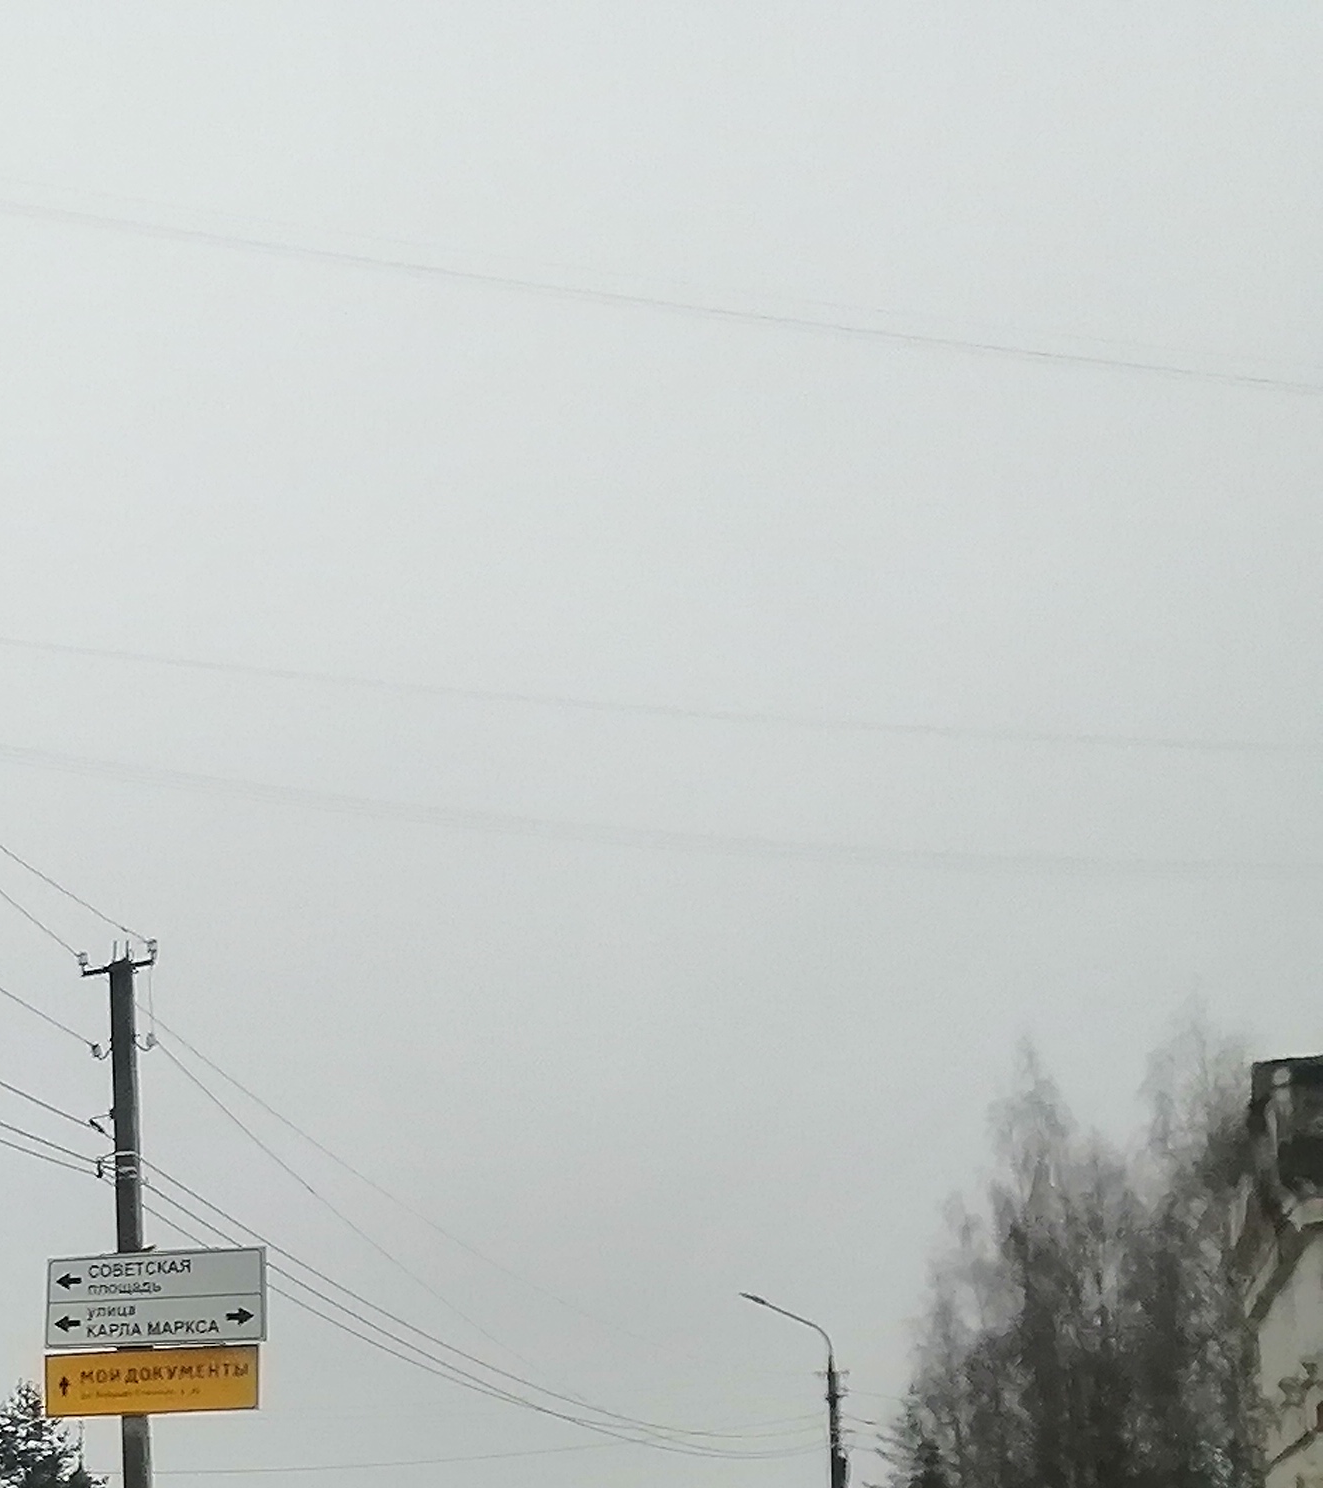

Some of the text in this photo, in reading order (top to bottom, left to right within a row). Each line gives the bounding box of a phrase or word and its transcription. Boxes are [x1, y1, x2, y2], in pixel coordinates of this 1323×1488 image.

[88, 1259, 191, 1278] СОВЕТСКАЯ
[88, 1282, 162, 1295] площадь
[87, 1306, 136, 1321] улица
[86, 1320, 220, 1338] КАРЛА МАРКСА
